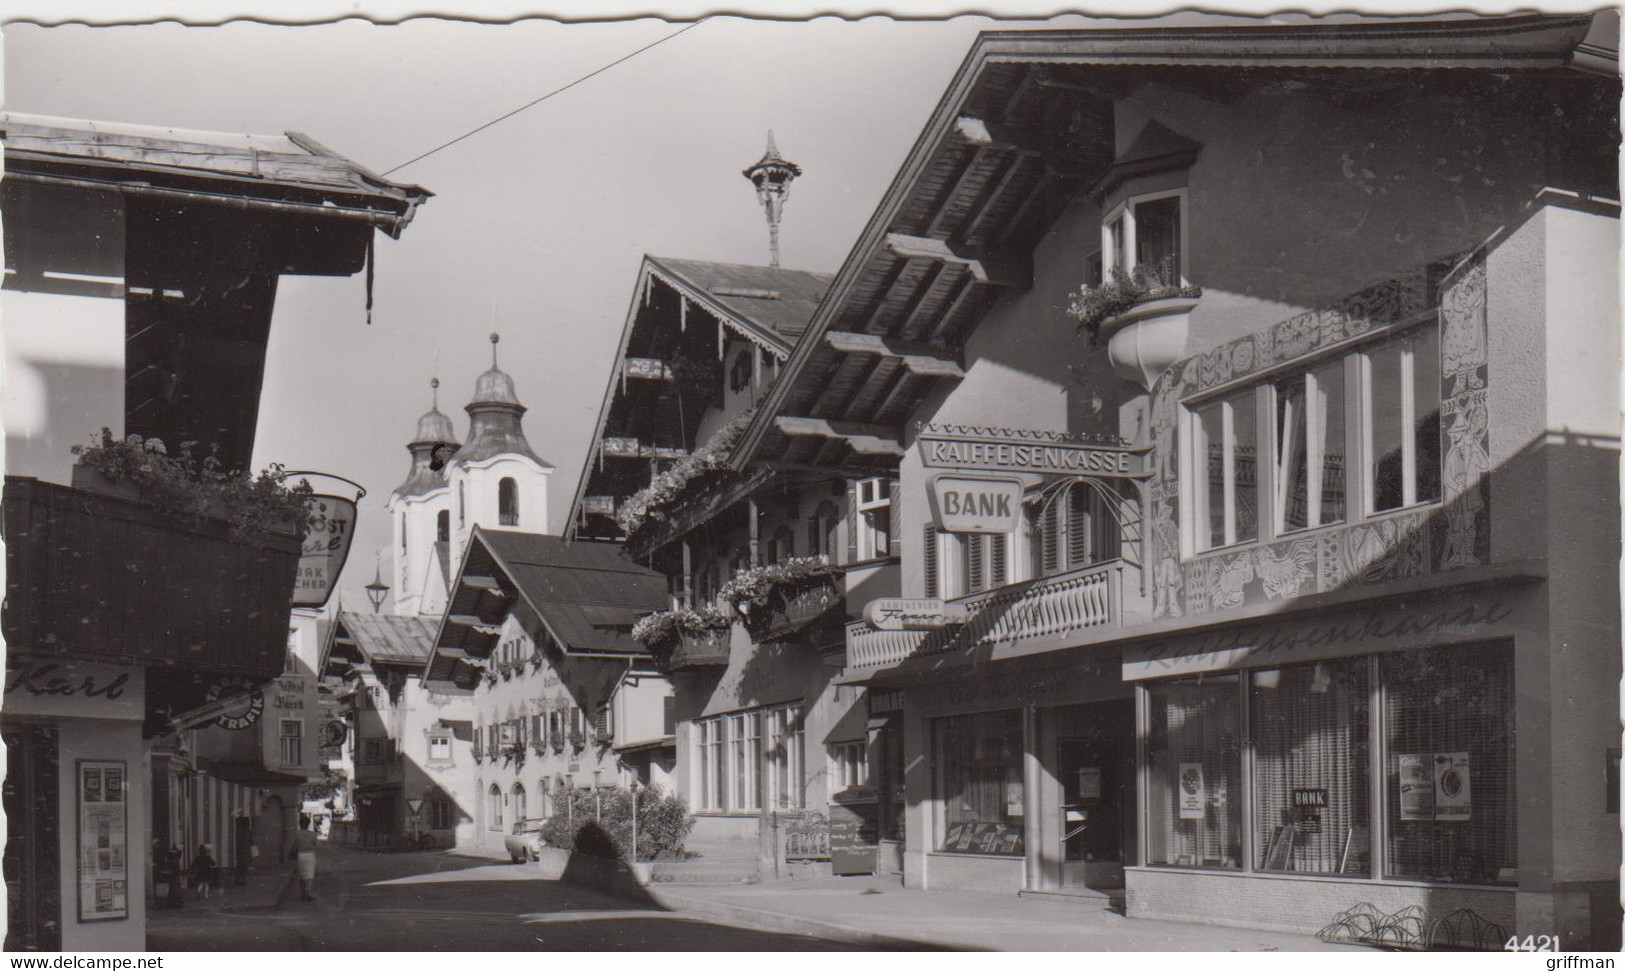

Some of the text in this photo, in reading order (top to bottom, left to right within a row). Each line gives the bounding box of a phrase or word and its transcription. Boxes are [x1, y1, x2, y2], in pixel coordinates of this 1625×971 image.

[930, 441, 1130, 473] RAIFFEISENKASSE
[943, 490, 1011, 518] BANK
[1142, 602, 1511, 669] Raiffeisenkasse
[5, 664, 129, 699] Karl
[218, 697, 263, 729] TRAFIK
[1295, 792, 1324, 805] BANK
